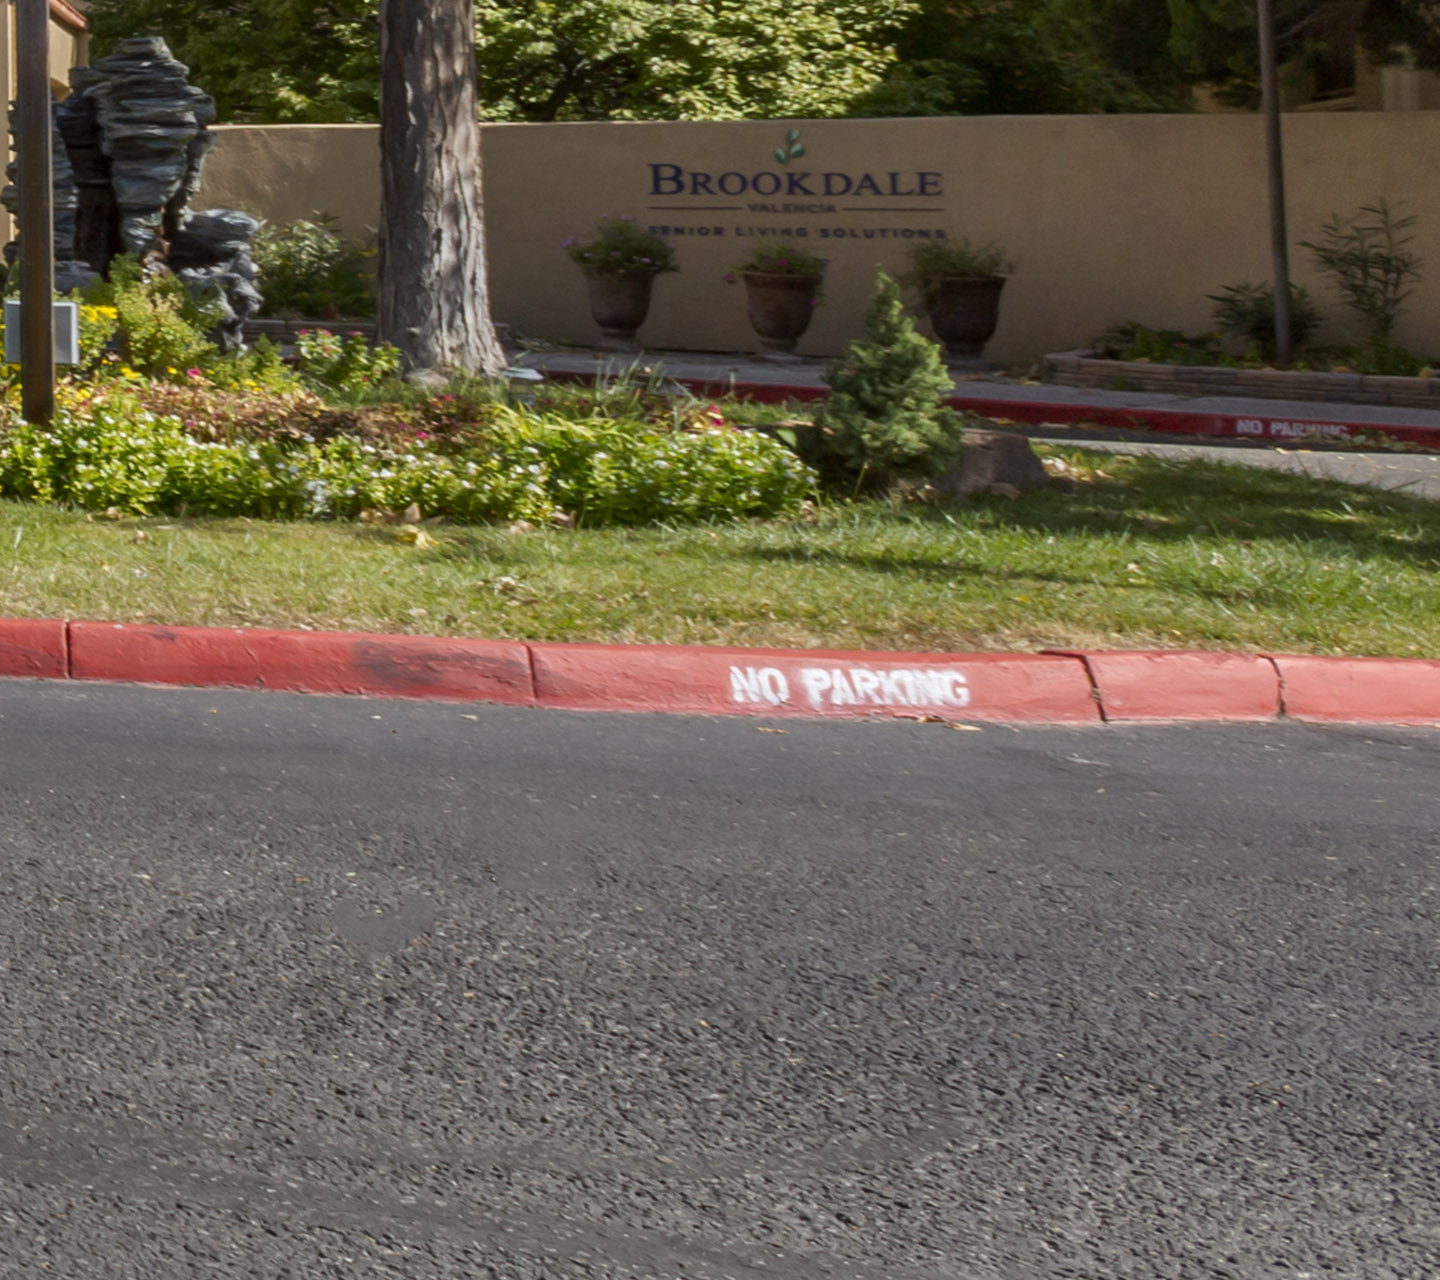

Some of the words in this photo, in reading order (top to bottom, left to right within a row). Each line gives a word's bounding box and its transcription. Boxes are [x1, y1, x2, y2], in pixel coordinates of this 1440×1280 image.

[647, 163, 944, 197] BROOKDALE
[747, 203, 838, 214] VALENCIA
[647, 225, 727, 237] SENIOR
[735, 226, 809, 238] LIVING
[819, 227, 947, 240] SOLUTIONS
[1236, 419, 1263, 434] NO
[729, 665, 791, 706] NO
[799, 667, 971, 707] PARKING
